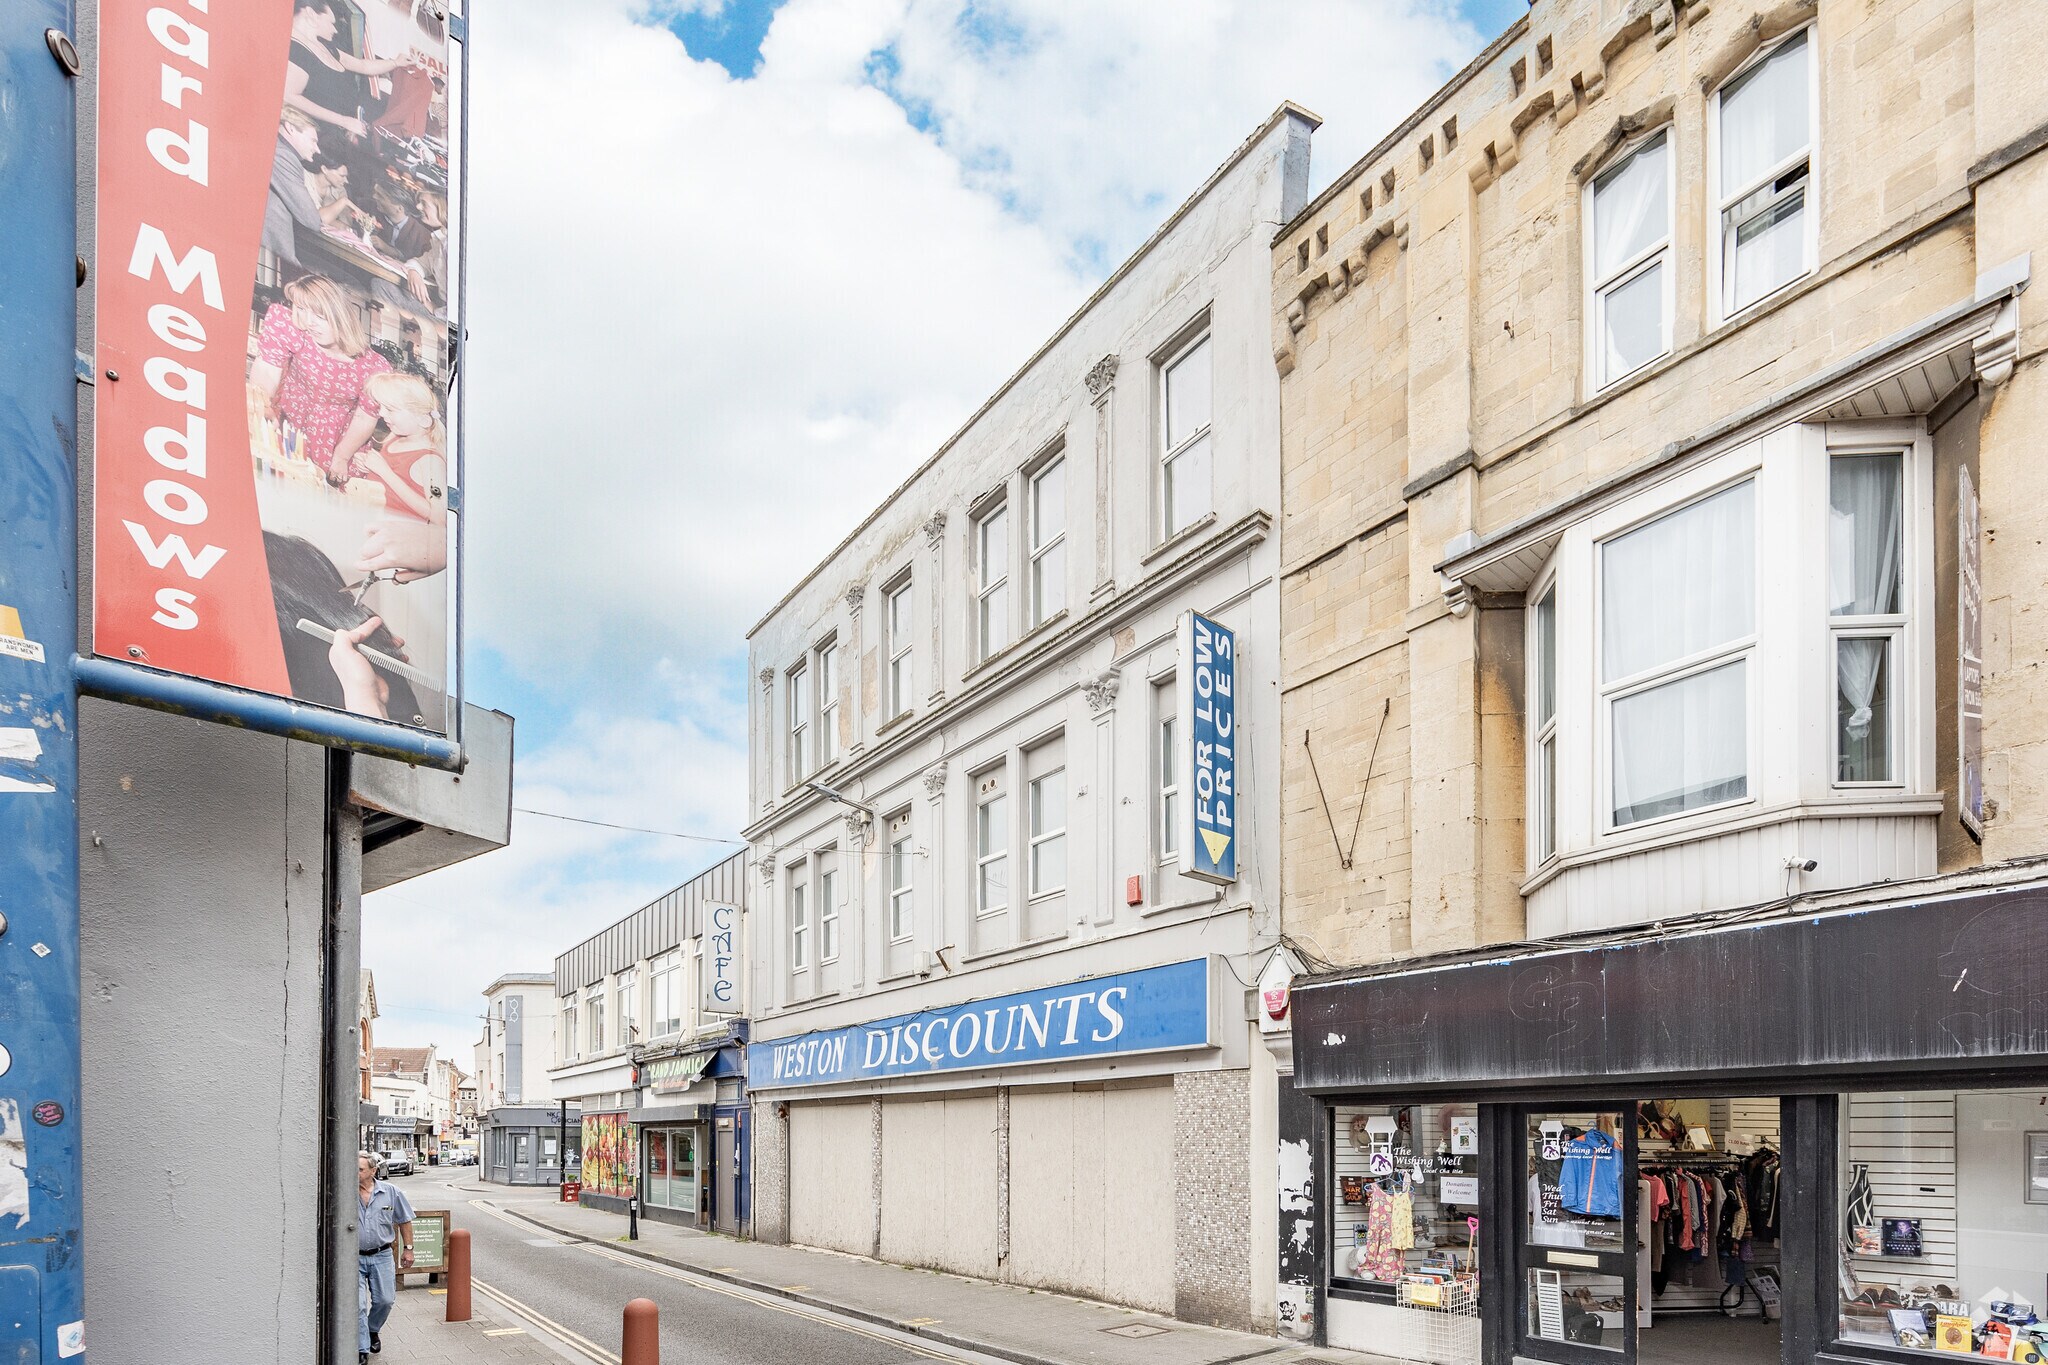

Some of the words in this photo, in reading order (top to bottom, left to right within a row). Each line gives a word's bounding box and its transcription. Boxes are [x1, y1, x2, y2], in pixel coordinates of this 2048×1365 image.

[419, 54, 447, 75] SAL
[146, 0, 209, 187] ard
[122, 222, 228, 630] Meadows
[1195, 620, 1213, 723] LOW
[1215, 631, 1234, 828] PRICES
[1196, 740, 1213, 825] FOR
[773, 1035, 848, 1080] WESTON
[862, 986, 1127, 1072] DISCOUNTS
[669, 1056, 705, 1077] JAMAICA
[1393, 1146, 1412, 1156] The
[1393, 1155, 1433, 1167] Wishing
[1437, 1156, 1463, 1166] Well
[1561, 1146, 1591, 1155] Wishing
[1593, 1146, 1612, 1154] Well
[1542, 1183, 1565, 1192] Wed
[1542, 1192, 1565, 1200] Thur
[1542, 1200, 1558, 1208] Fri
[1541, 1215, 1559, 1224] Sun
